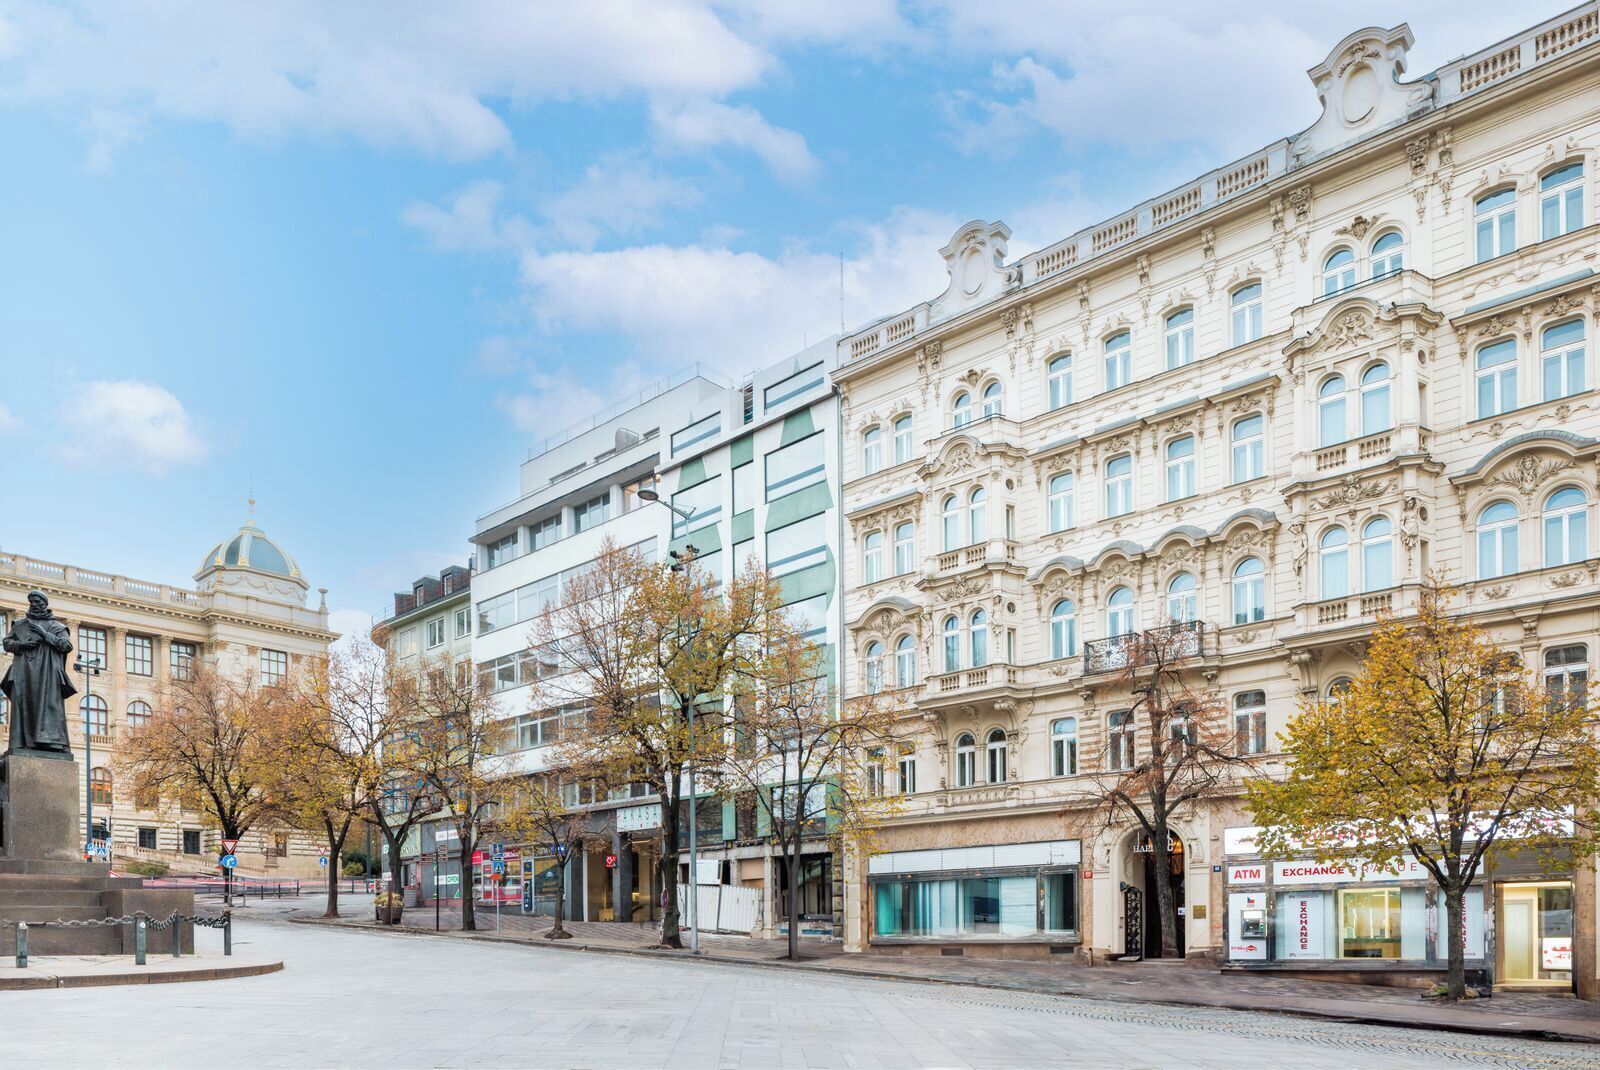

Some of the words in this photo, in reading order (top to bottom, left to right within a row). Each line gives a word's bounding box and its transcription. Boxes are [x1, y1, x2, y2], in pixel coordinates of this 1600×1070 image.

[623, 805, 657, 822] AKASA
[1234, 869, 1261, 880] ATM
[1282, 866, 1344, 877] EXCHANGE
[1300, 901, 1308, 950] EXCHANGE
